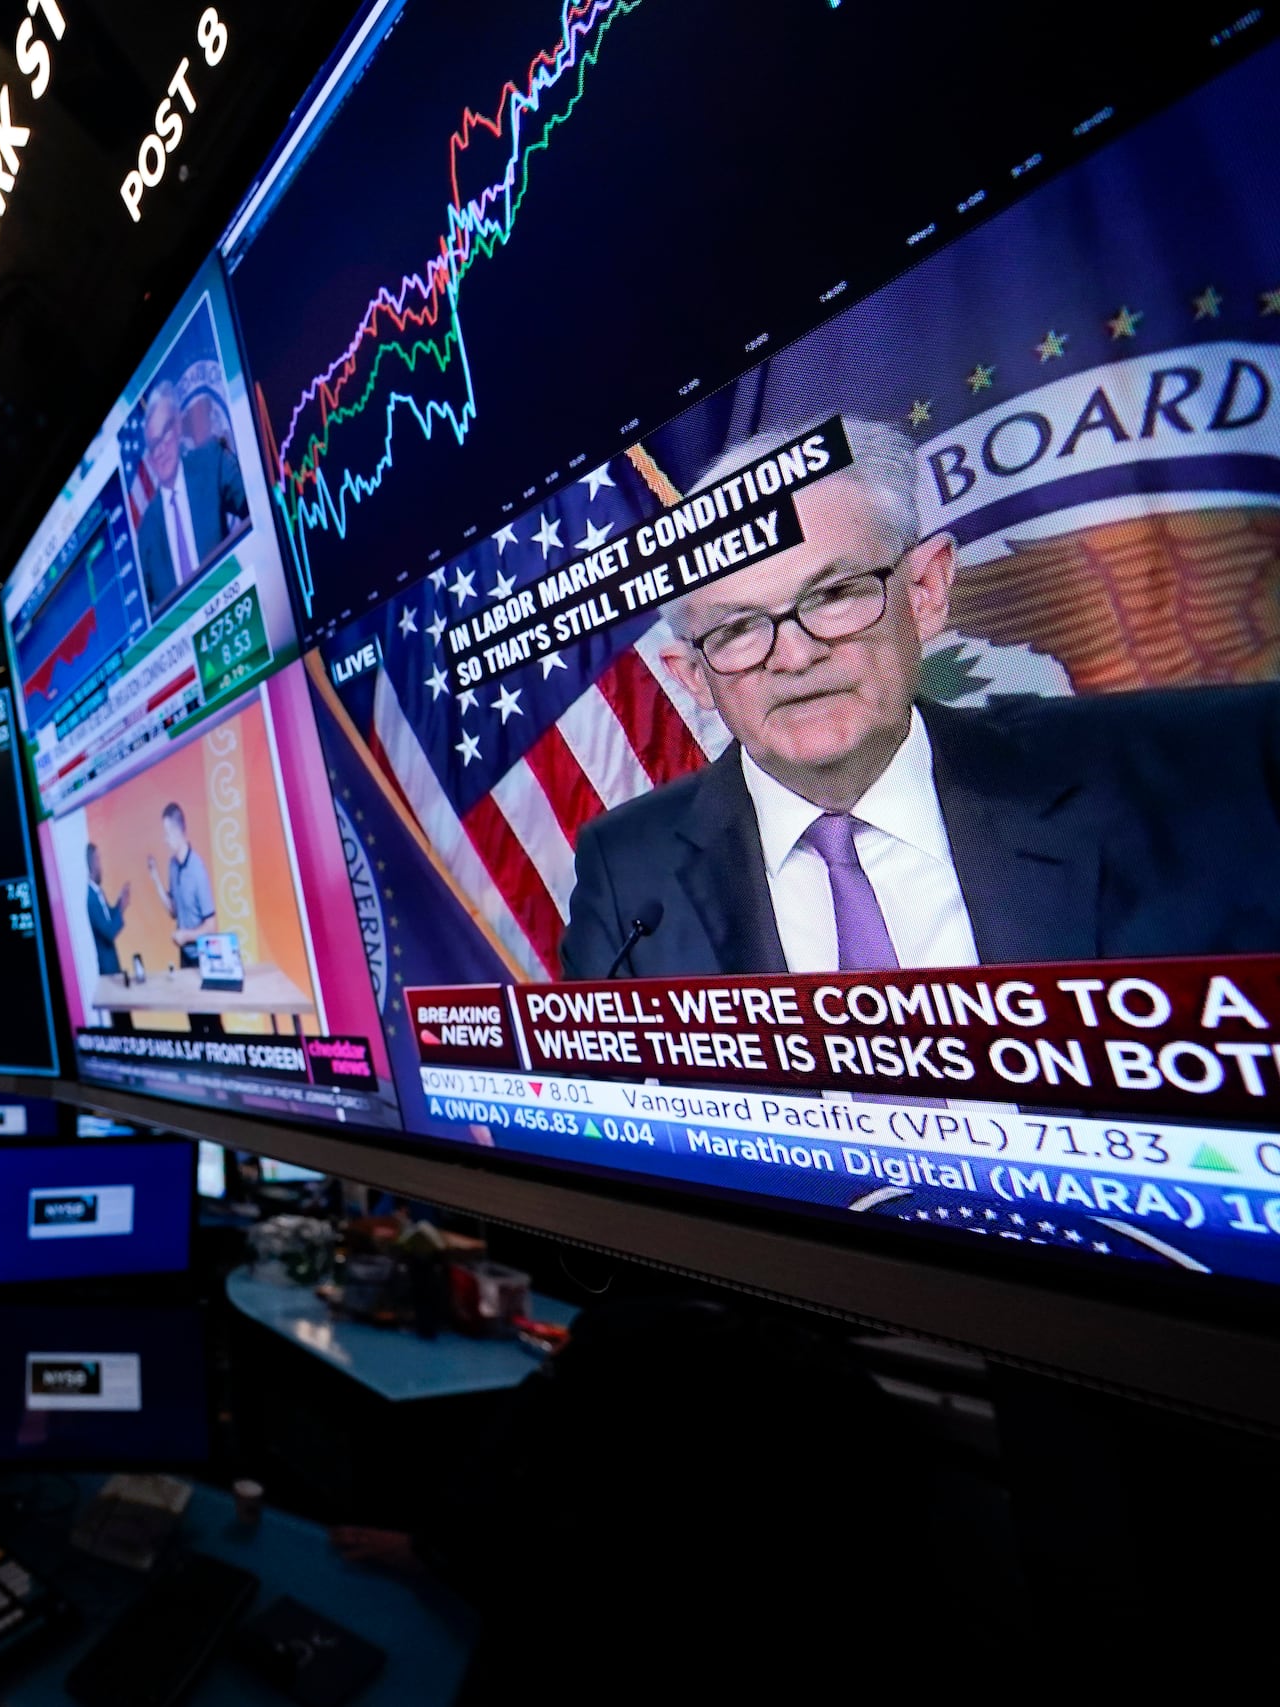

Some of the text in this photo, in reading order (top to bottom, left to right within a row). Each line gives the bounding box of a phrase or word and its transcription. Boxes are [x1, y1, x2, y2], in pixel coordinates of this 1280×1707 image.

[120, 7, 228, 222] POST 8
[927, 358, 1271, 506] BOARD
[449, 434, 830, 654] IN LABOR MARKET CONDITIONS
[457, 508, 779, 687] SO THAT'S STILL THE LIKELY
[335, 643, 377, 682] LIVE
[418, 1007, 501, 1023] BREAKING
[441, 1025, 503, 1047] NEWS
[527, 975, 1269, 1029] POWELL: WE'RE COMING TO A
[206, 1042, 247, 1066] FRONT
[247, 1044, 306, 1072] SCREEN
[534, 1030, 1280, 1097] WHERE THERE IS RISKS ON BOT
[471, 1076, 526, 1098] 171.28
[550, 1082, 594, 1105] 8.01
[622, 1088, 752, 1121] Vanguard
[762, 1099, 875, 1135] Pacific
[889, 1111, 1007, 1151] (VPL)
[1024, 1122, 1169, 1165] 71.83
[430, 1098, 444, 1117] A
[445, 1099, 510, 1128] (NVDA)
[513, 1107, 579, 1137] 456.83
[603, 1118, 655, 1146] 0.04
[686, 1127, 835, 1172] Marathon
[841, 1145, 977, 1192] Digital
[989, 1165, 1206, 1230] (MARA)
